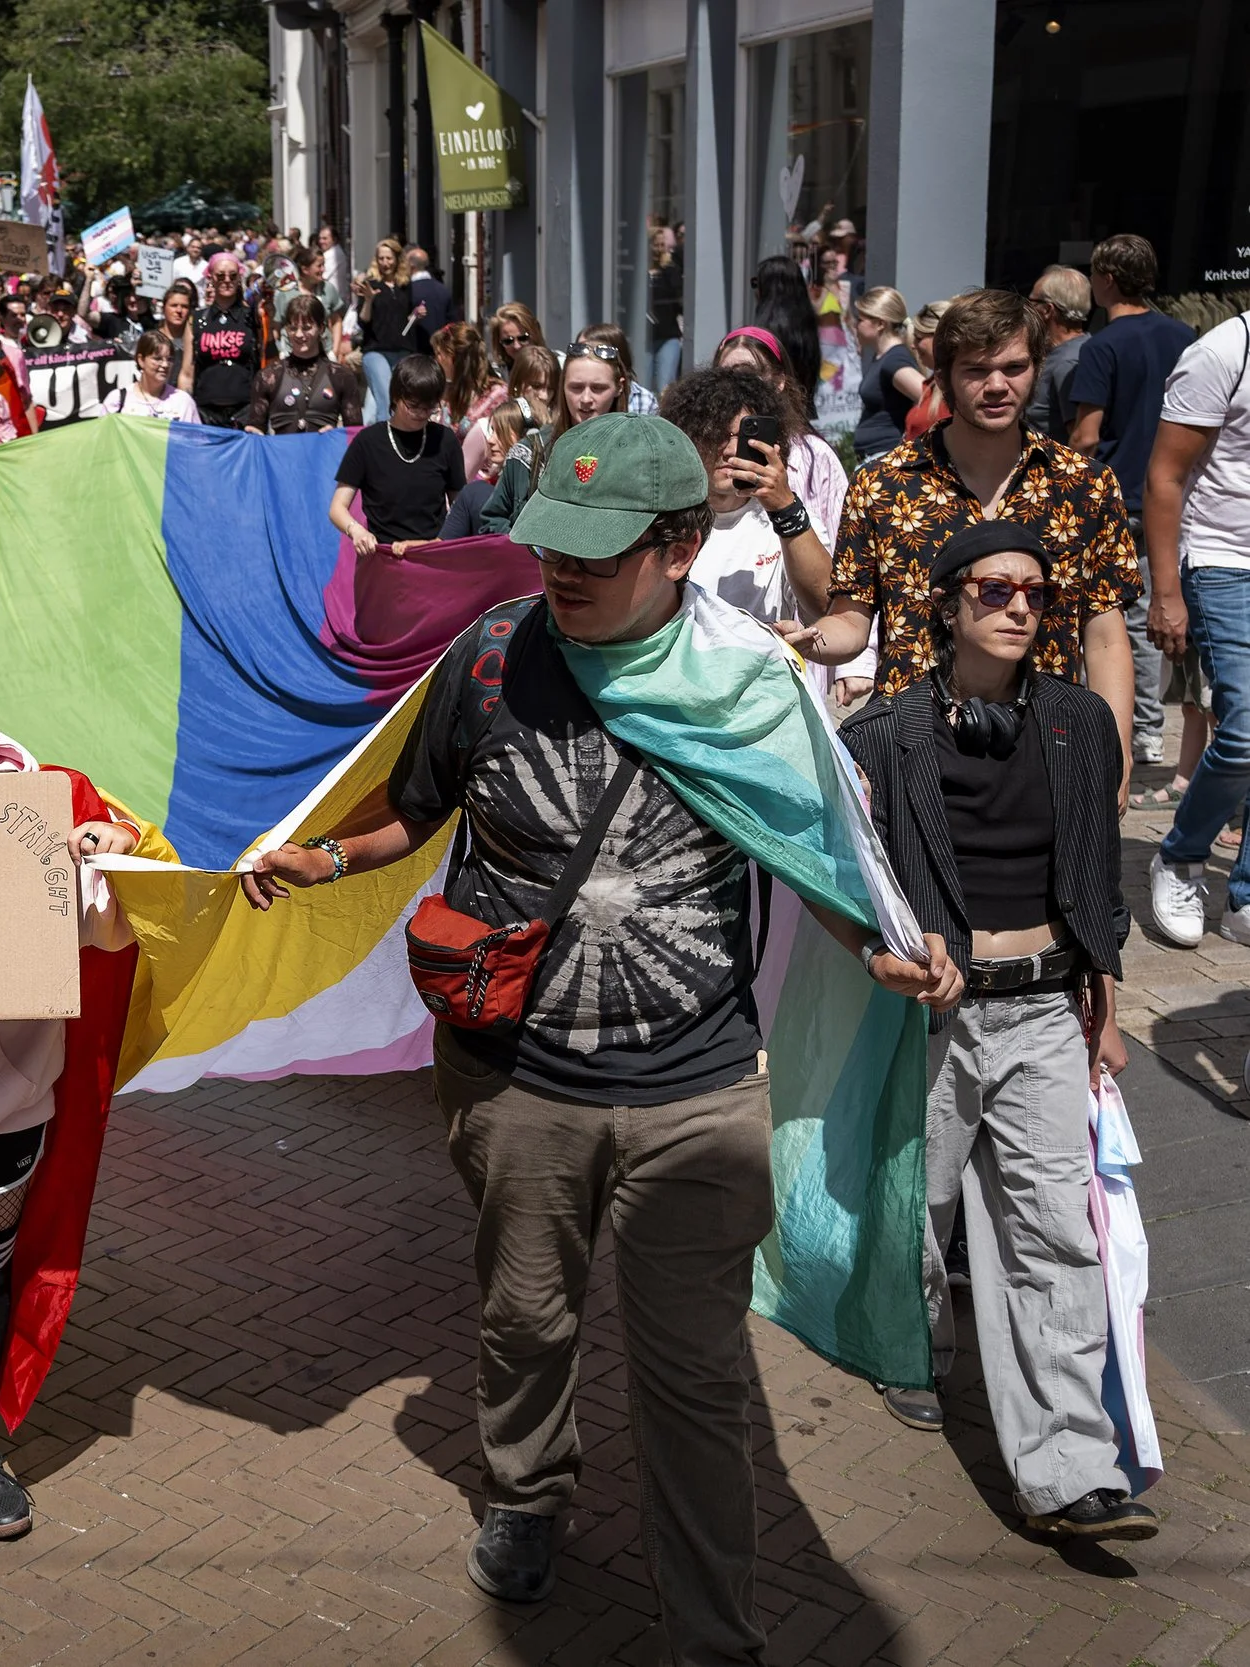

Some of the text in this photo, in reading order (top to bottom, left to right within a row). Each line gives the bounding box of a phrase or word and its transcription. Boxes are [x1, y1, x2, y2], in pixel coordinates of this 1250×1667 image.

[439, 126, 516, 156] EINDELOOS!
[467, 156, 477, 170] IN
[200, 330, 246, 352] LINKSE
[34, 354, 48, 366] all
[48, 351, 76, 365] kinds
[75, 350, 88, 361] of
[87, 348, 115, 361] queer
